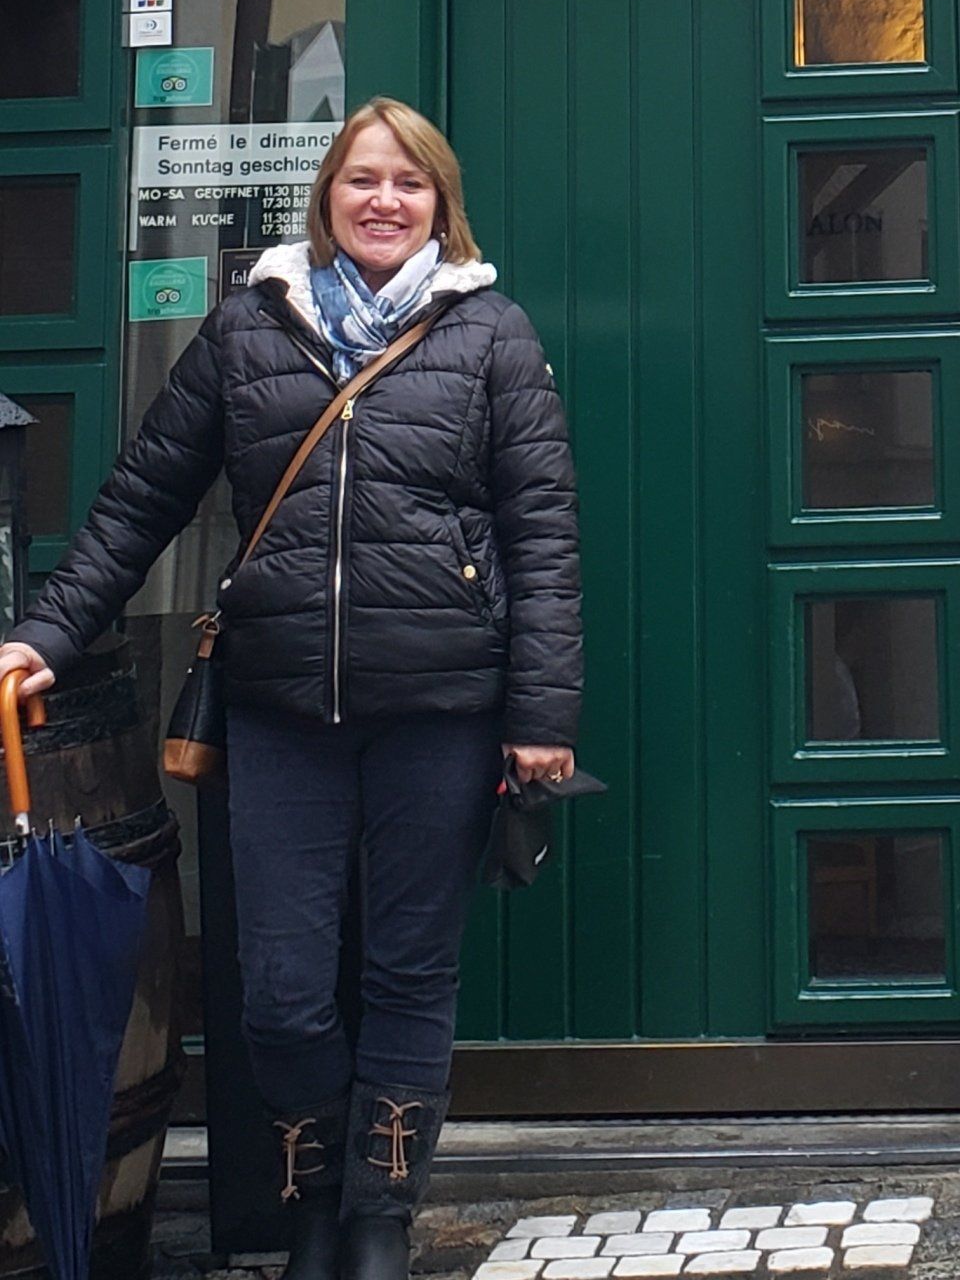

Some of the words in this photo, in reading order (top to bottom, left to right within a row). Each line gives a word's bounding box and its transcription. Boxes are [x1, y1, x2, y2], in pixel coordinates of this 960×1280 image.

[158, 134, 217, 151] Fermé
[230, 134, 247, 150] le
[158, 159, 233, 177] Sonntag
[139, 188, 185, 200] MO-SA
[293, 186, 311, 197] BIS
[293, 197, 310, 208] BIS
[139, 215, 177, 227] WARM
